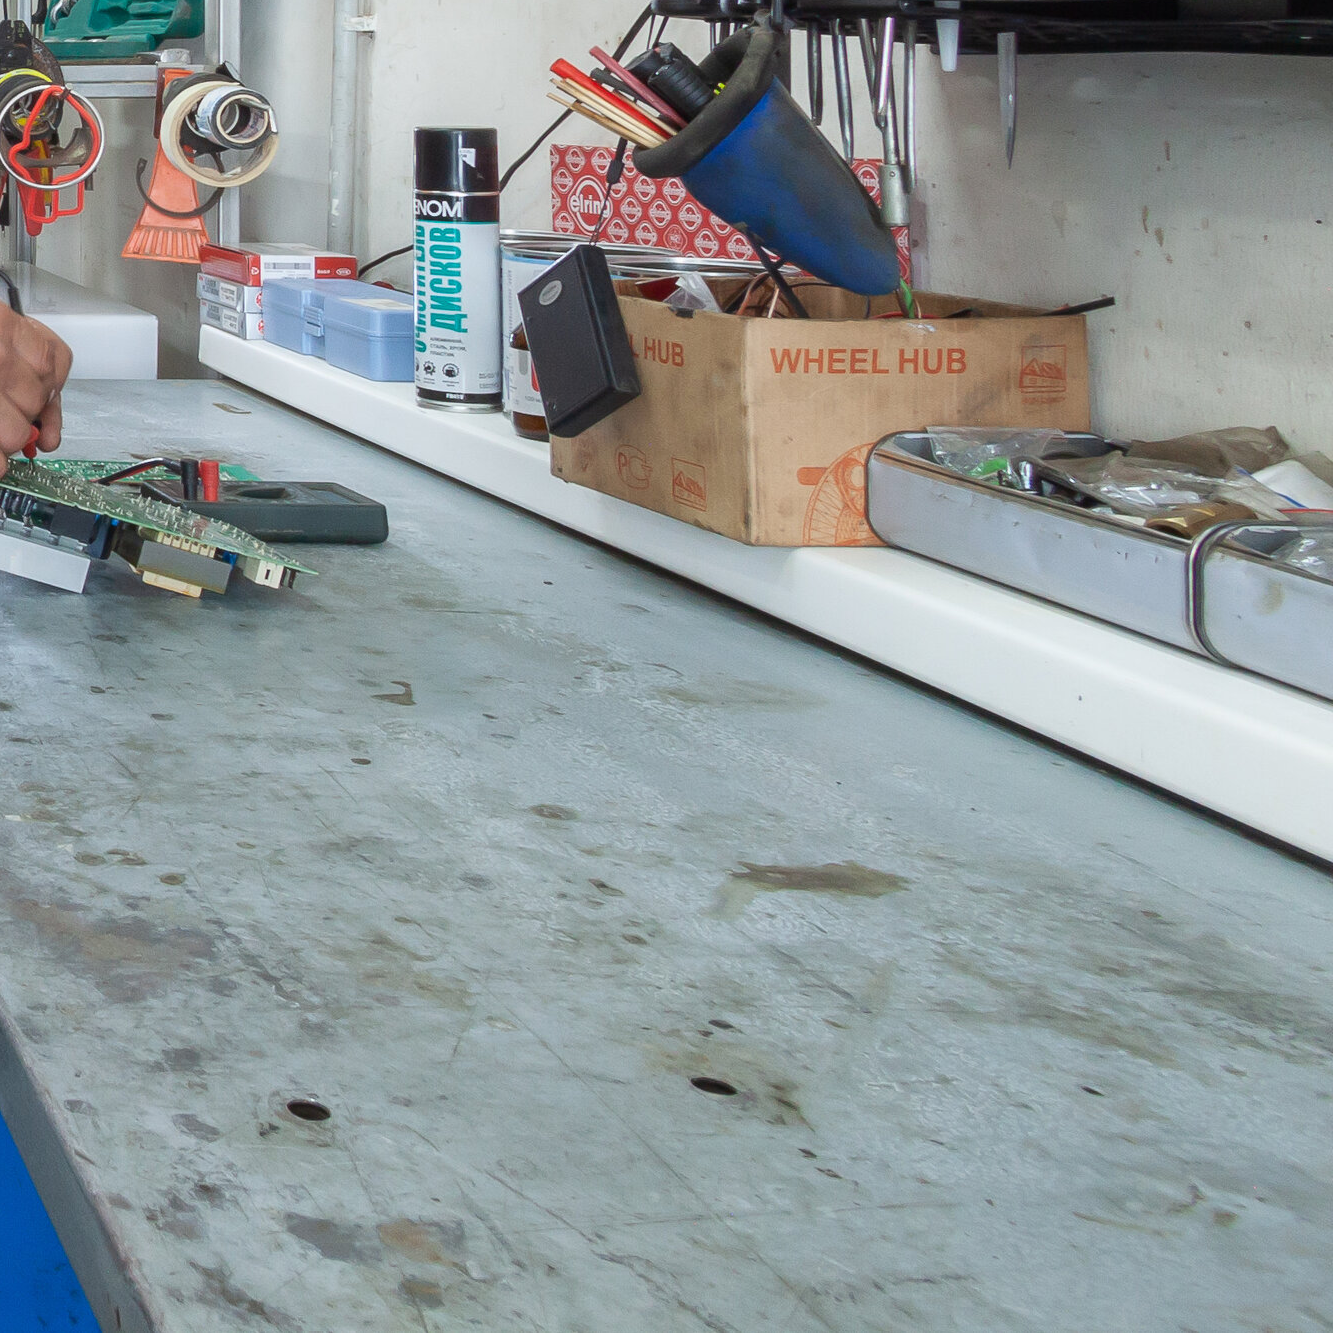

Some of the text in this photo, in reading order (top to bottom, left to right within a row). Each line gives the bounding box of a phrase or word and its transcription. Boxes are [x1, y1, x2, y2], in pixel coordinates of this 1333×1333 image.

[429, 227, 468, 333] ДИСКОВ
[644, 336, 685, 367] HUB
[770, 348, 967, 375] WHEEL HUB
